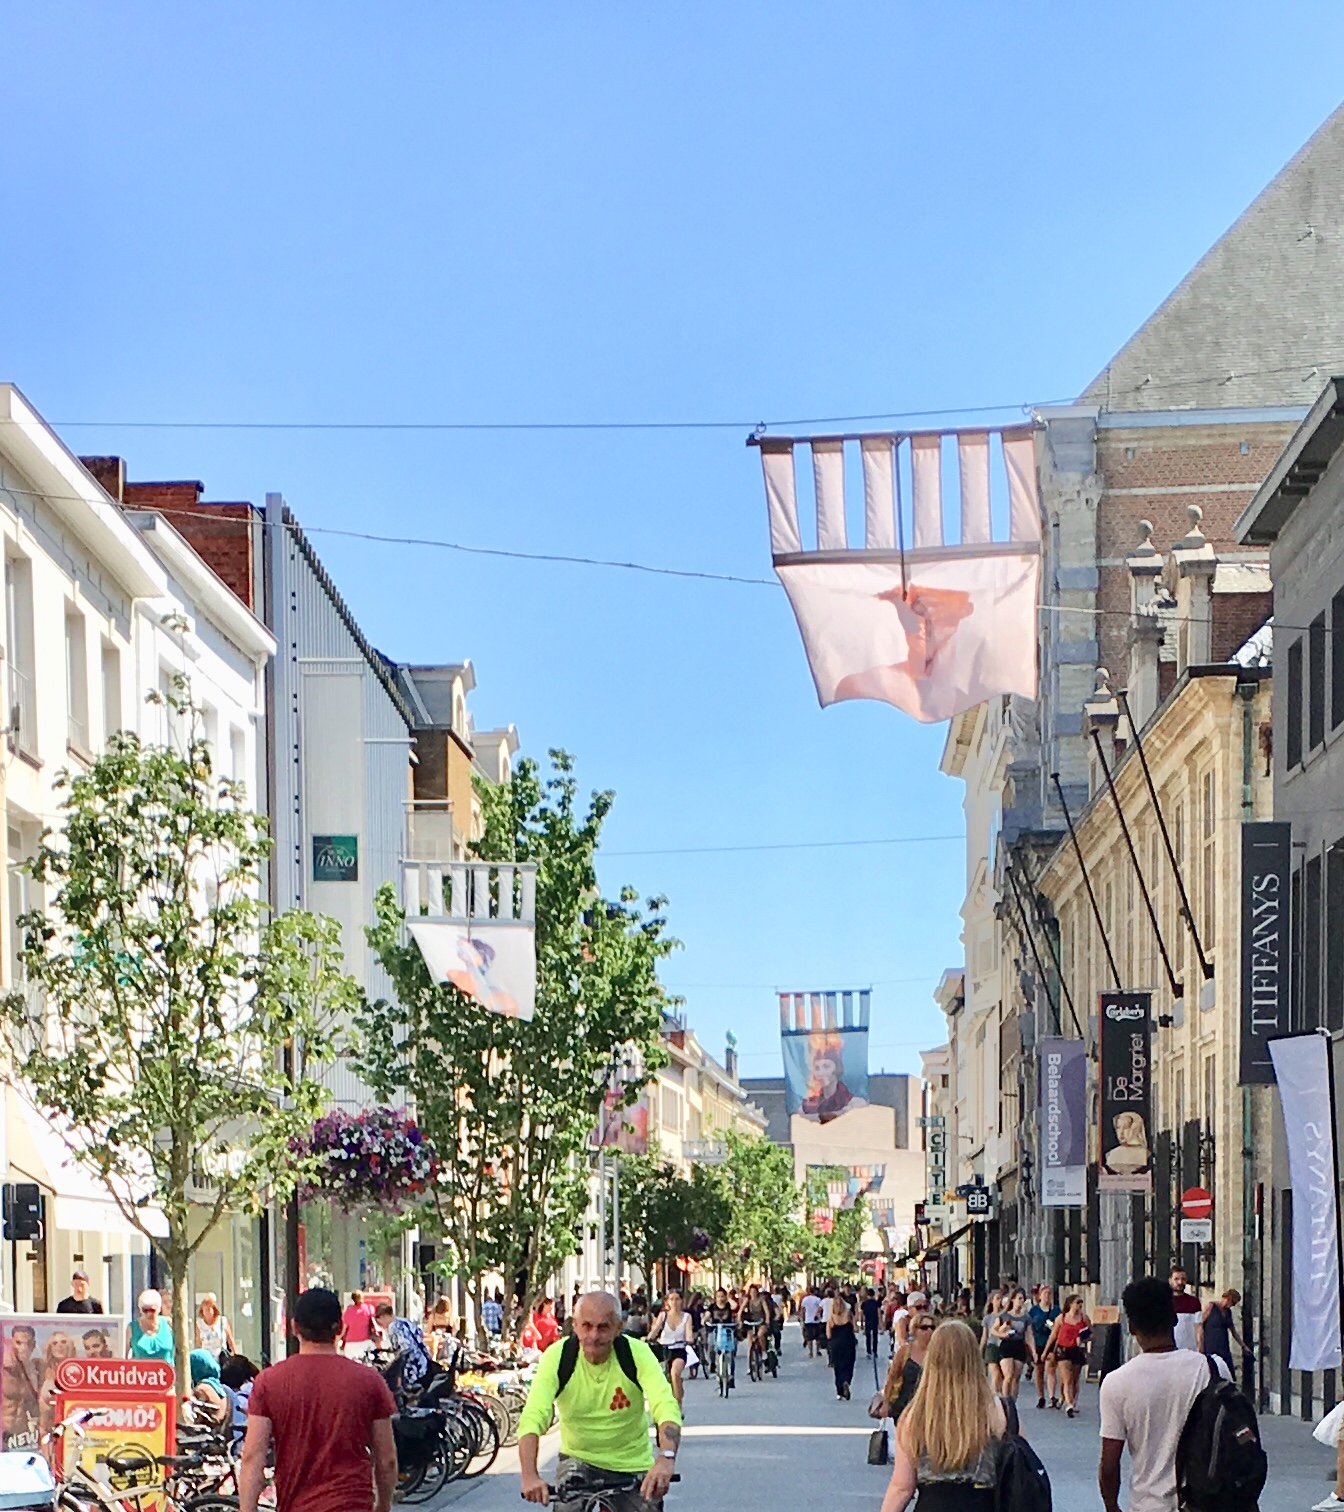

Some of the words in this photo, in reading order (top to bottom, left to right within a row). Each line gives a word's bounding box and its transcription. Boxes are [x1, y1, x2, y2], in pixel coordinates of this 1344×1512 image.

[319, 855, 355, 868] INNO
[1251, 872, 1280, 1035] TIFFANYS
[1106, 1003, 1145, 1022] Carlsberg
[1128, 1033, 1147, 1101] Margriet
[1113, 1076, 1128, 1101] De
[86, 1365, 168, 1386] Kruidvat
[72, 1405, 157, 1428] OMO!
[7, 1430, 40, 1450] NEW
